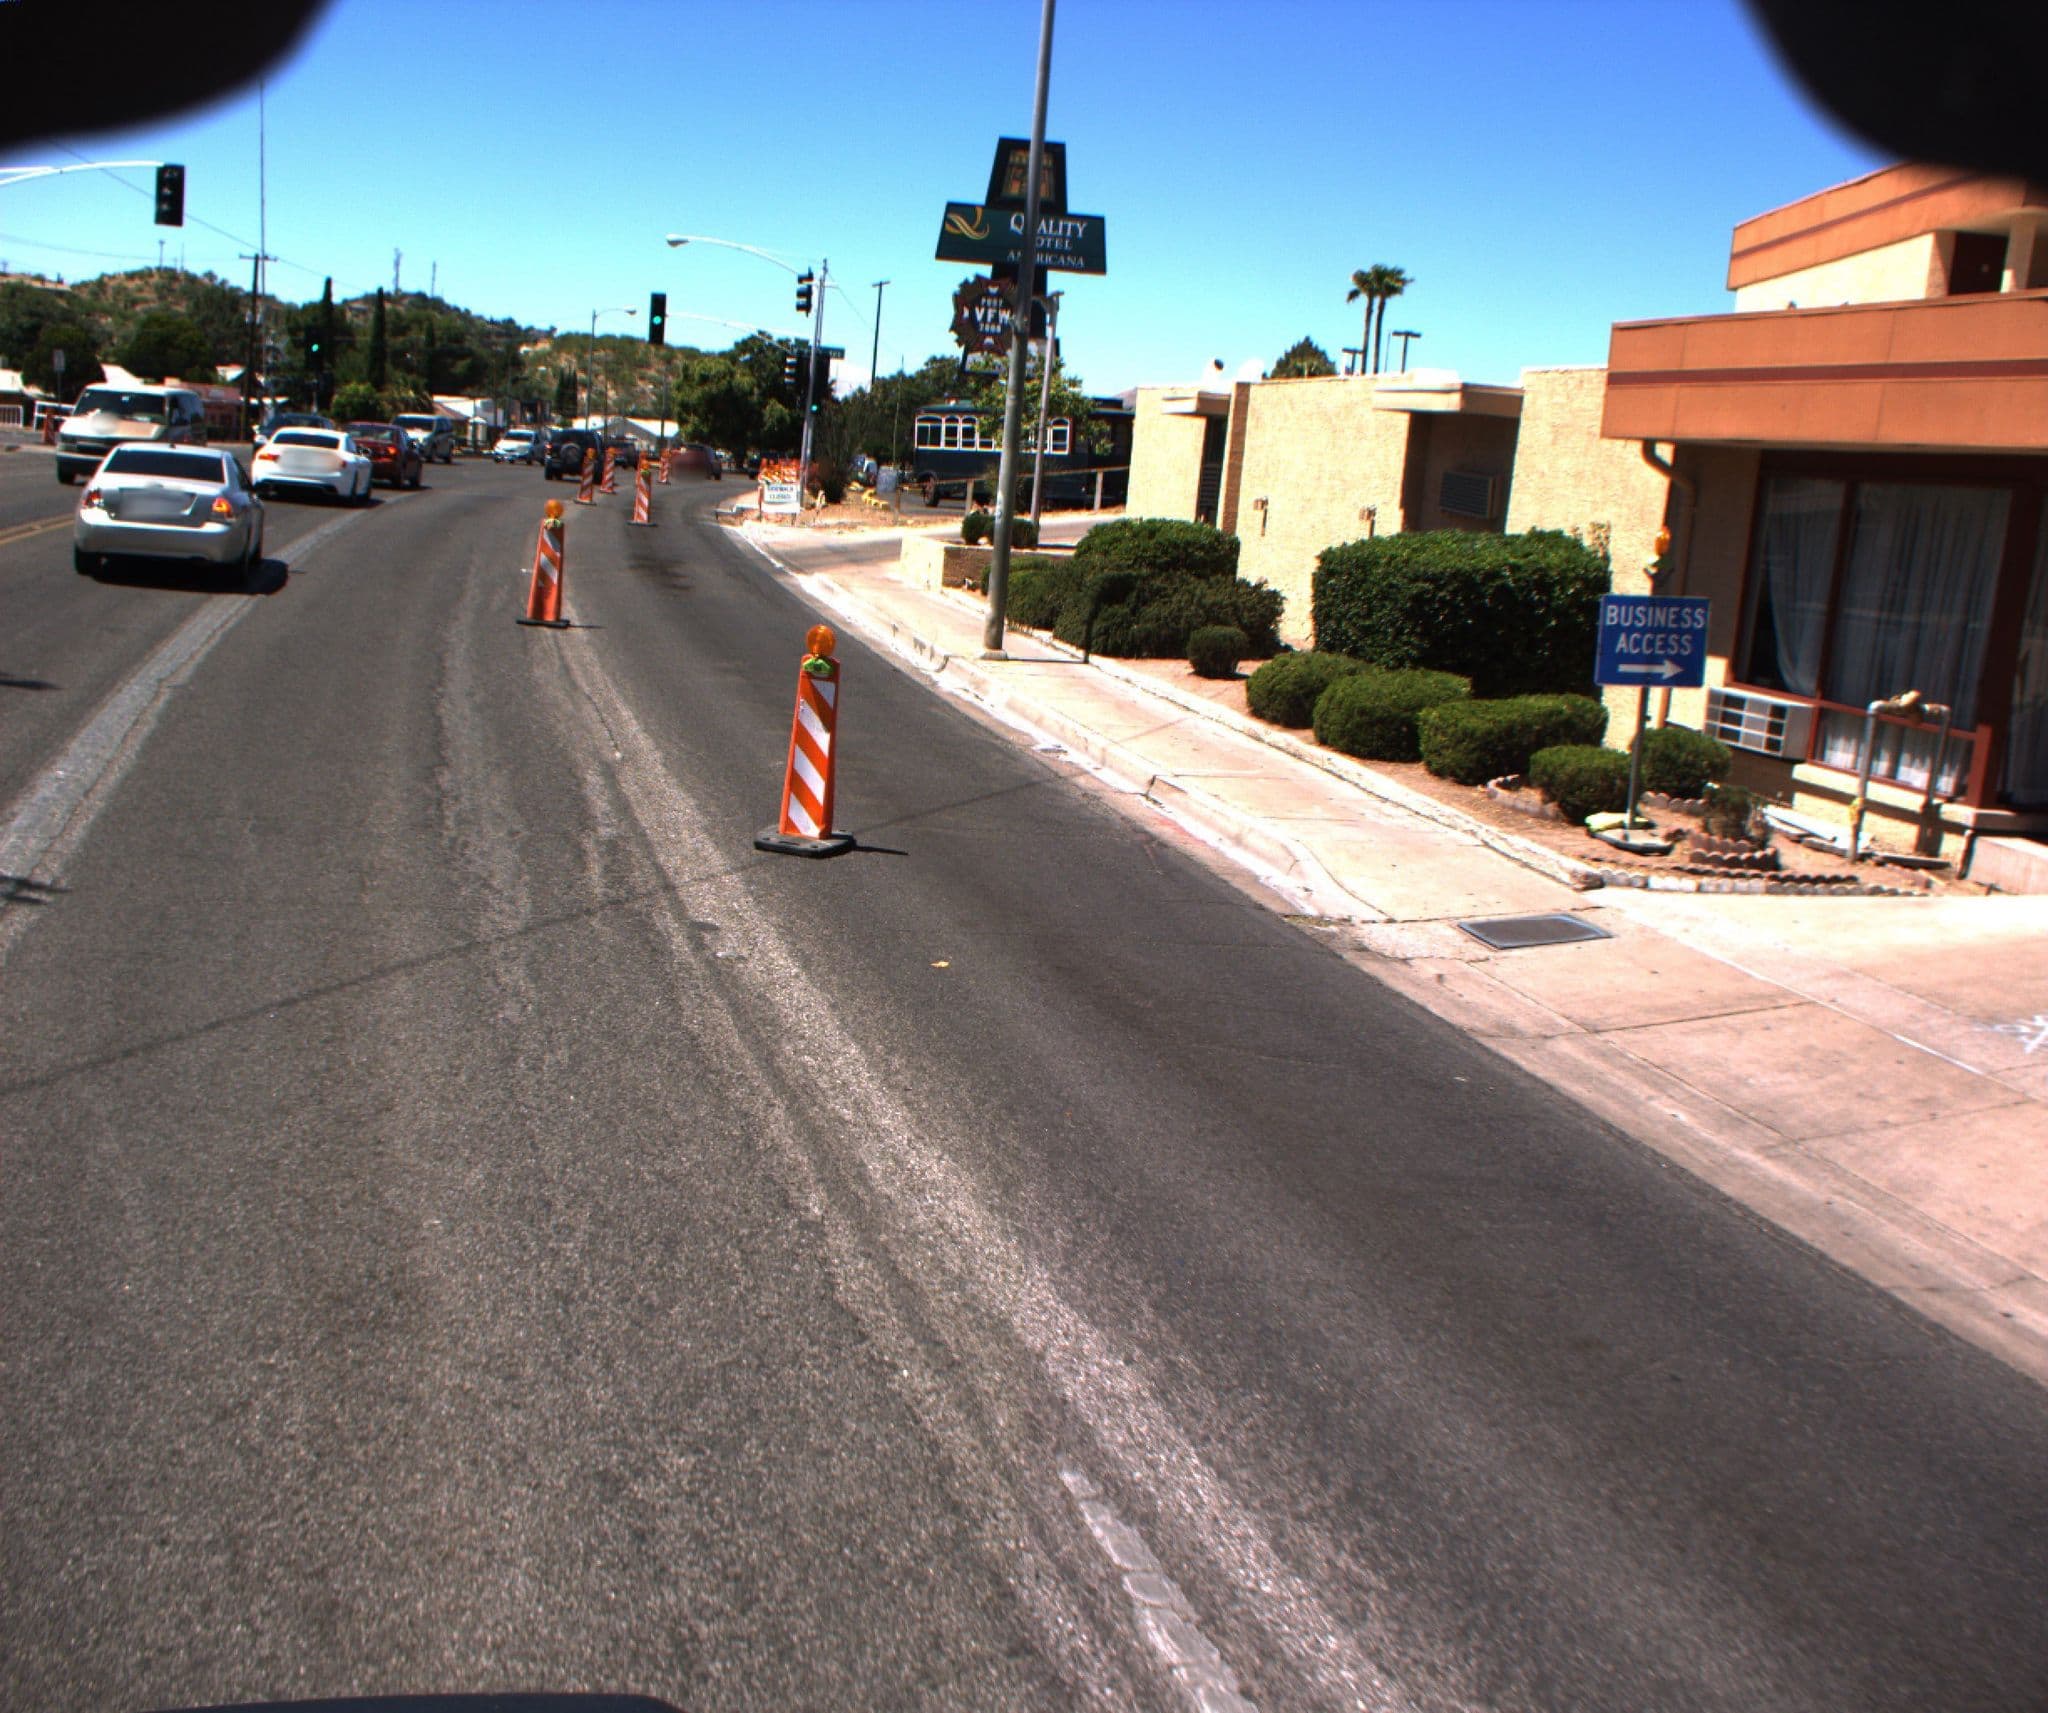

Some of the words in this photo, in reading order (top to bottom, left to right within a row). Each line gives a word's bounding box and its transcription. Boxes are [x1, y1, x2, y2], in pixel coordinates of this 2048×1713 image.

[1010, 212, 1088, 238] QALITY
[1030, 236, 1073, 251] OTEL
[1007, 249, 1085, 268] ARICANA
[974, 305, 1011, 325] VFW
[1606, 605, 1706, 629] BUSINESS
[1615, 632, 1693, 655] ACCESS
